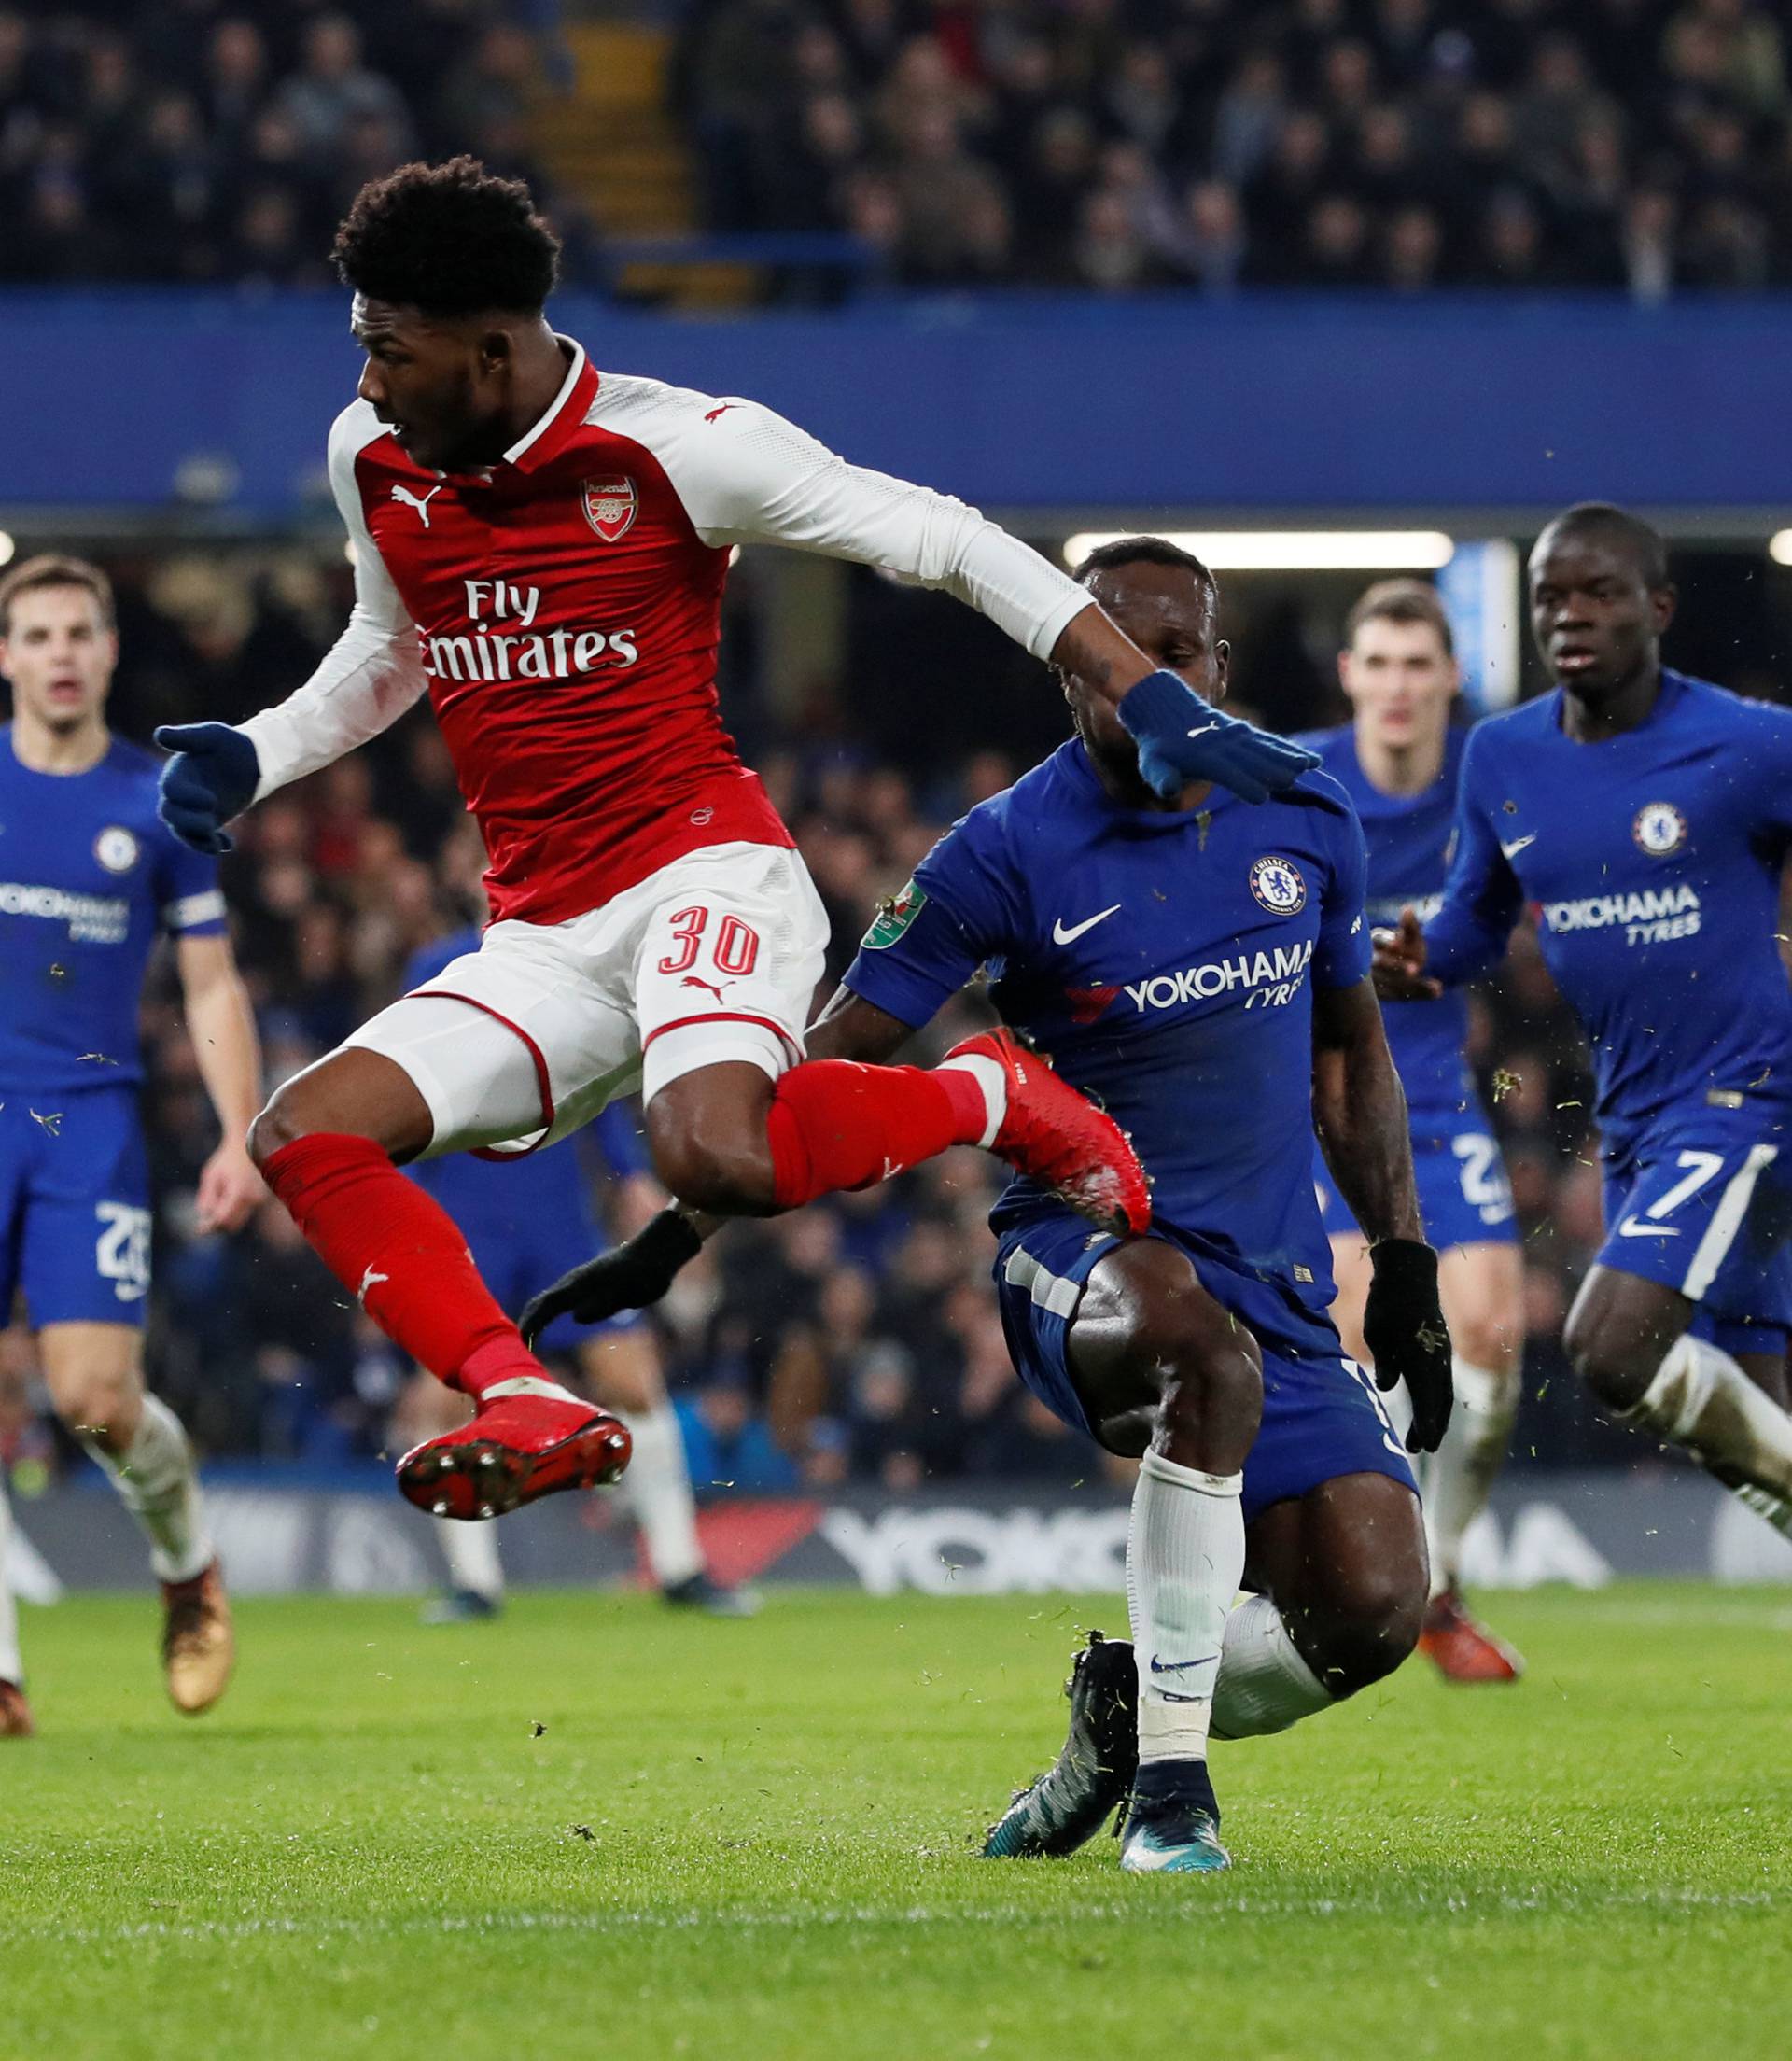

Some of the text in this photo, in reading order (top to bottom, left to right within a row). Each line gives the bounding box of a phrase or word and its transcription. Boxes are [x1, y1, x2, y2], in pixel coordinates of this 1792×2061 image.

[587, 484, 630, 494] Arsenal
[464, 580, 539, 626] Fly
[1253, 858, 1289, 875] CHELSEA
[1544, 885, 1700, 932] YOKOHAMA
[1626, 907, 1701, 946] TYRES
[658, 905, 760, 975] 30
[1645, 1149, 1724, 1220] 7
